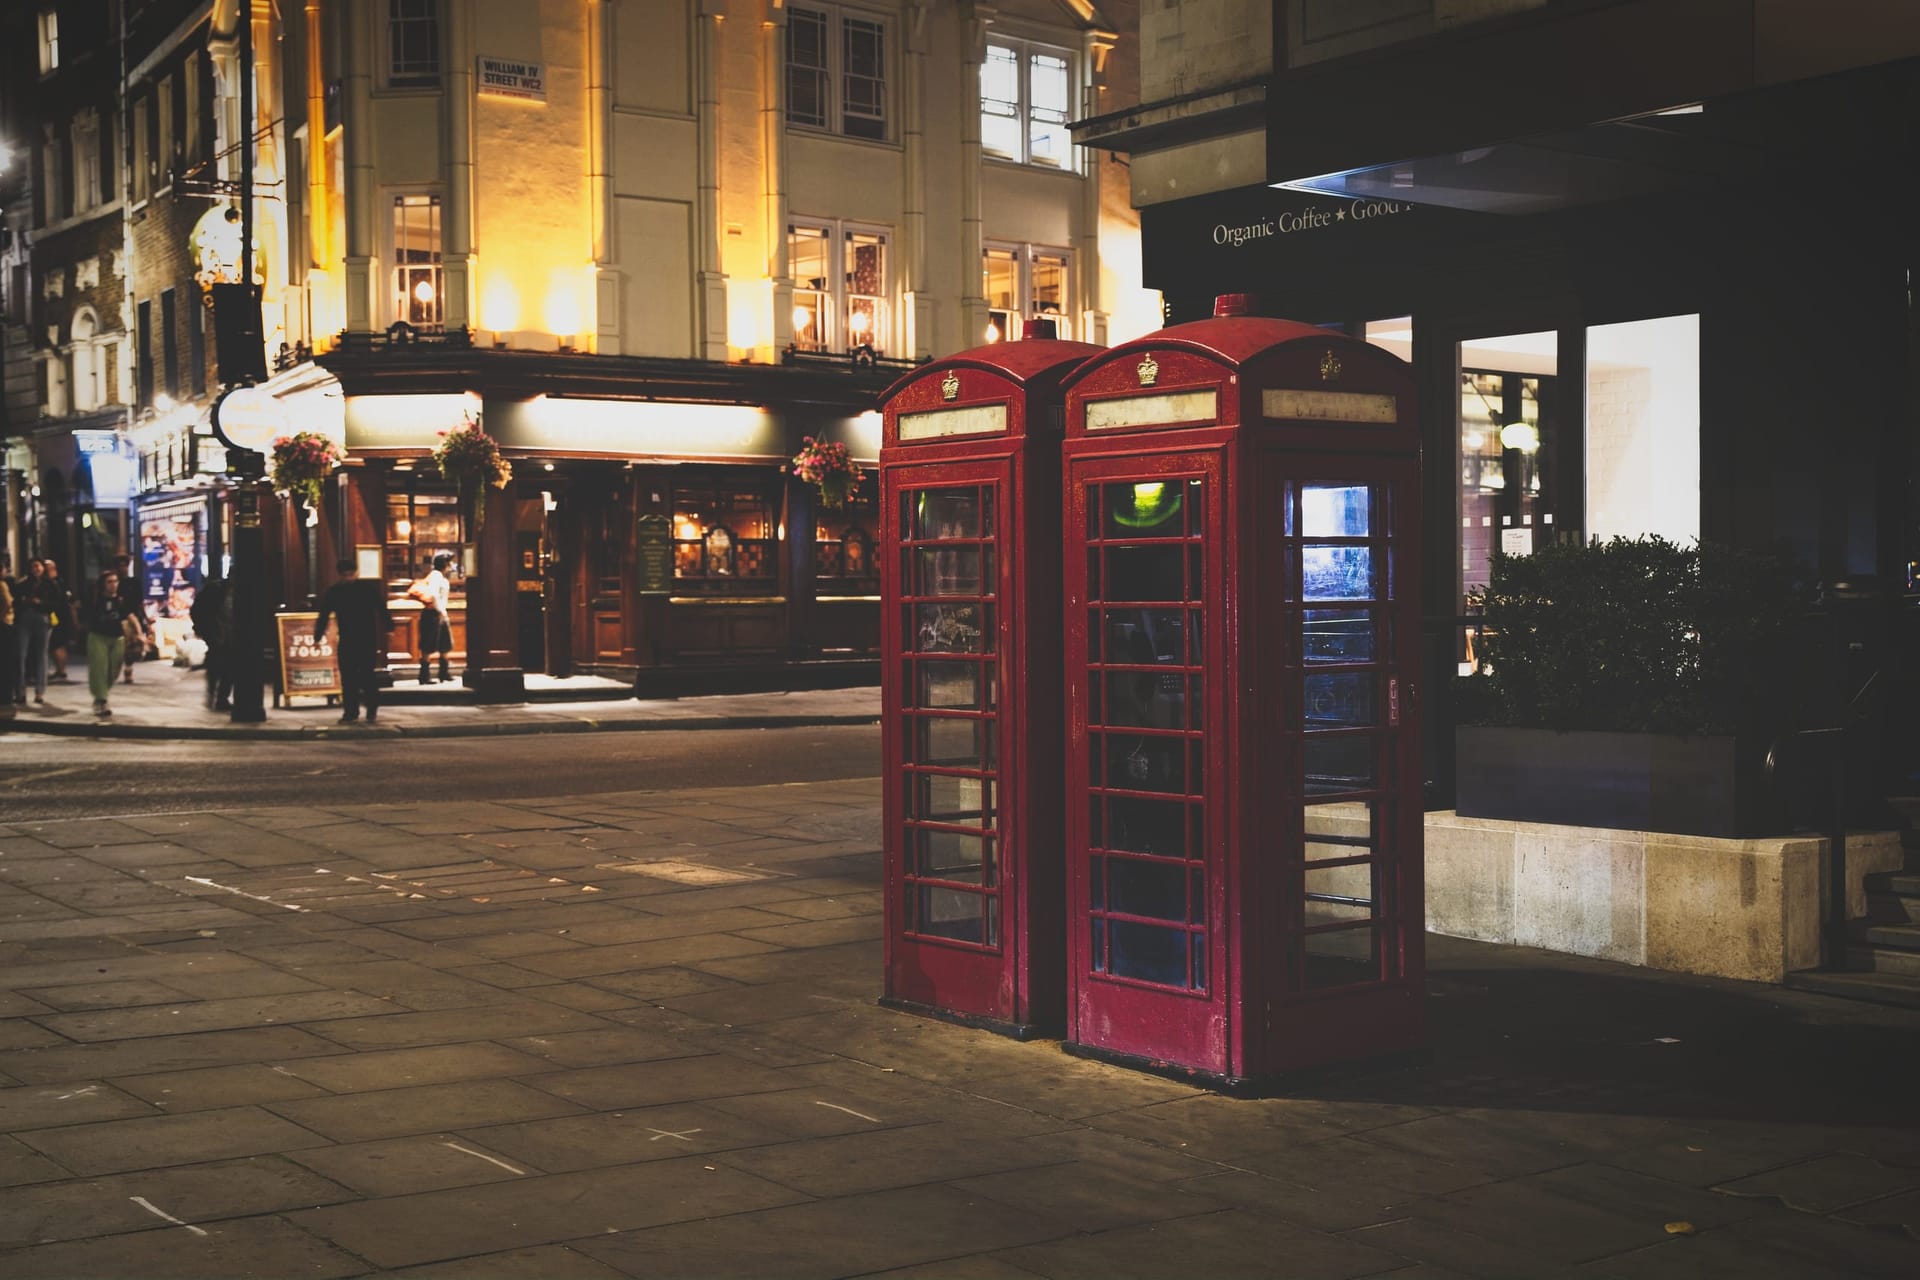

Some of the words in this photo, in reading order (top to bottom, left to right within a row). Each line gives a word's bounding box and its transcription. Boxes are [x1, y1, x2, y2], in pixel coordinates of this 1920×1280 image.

[484, 60, 525, 76] WILLIAM
[528, 66, 538, 78] IV
[484, 72, 518, 87] STREET
[521, 77, 542, 90] WC2
[1213, 215, 1275, 247] Organic
[1279, 206, 1331, 233] Coffee
[1351, 199, 1399, 221] Good
[289, 646, 333, 658] FOOD
